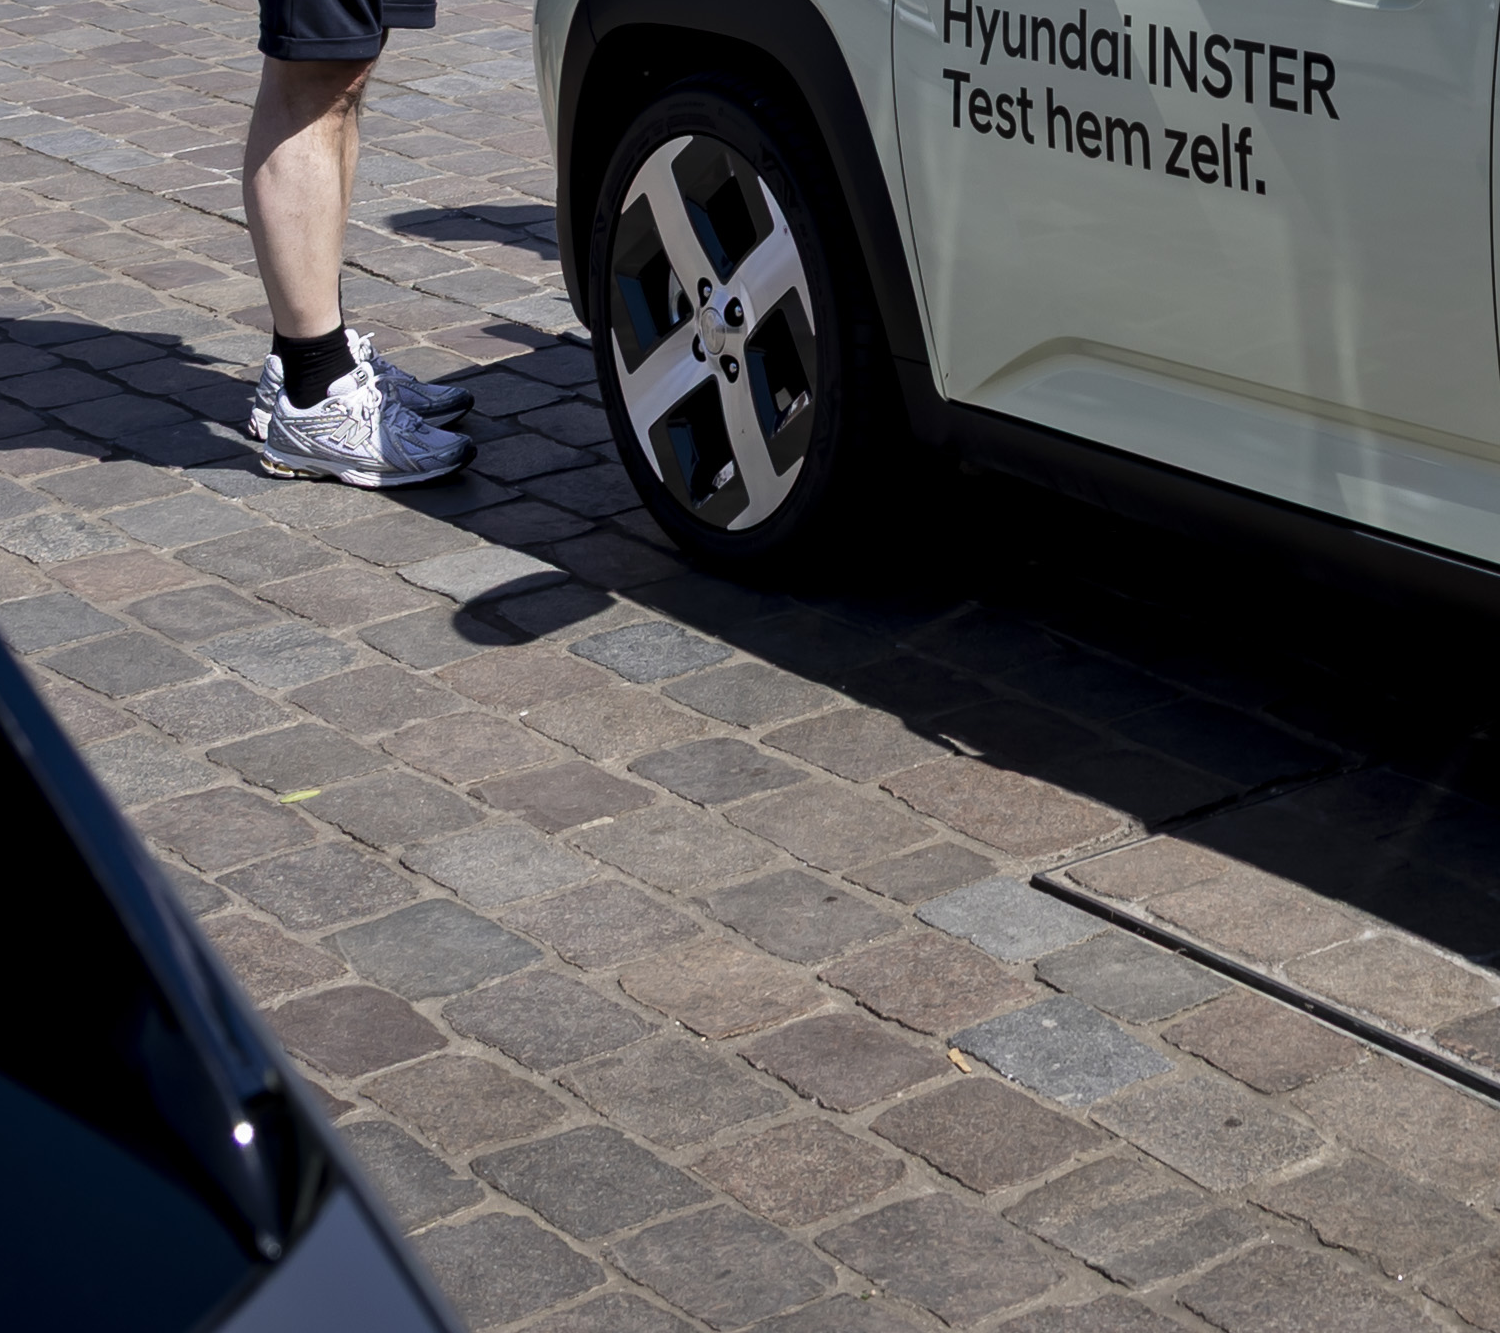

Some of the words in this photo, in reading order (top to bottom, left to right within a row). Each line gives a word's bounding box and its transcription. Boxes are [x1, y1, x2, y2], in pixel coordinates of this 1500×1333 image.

[1148, 22, 1340, 121] INSTER
[942, 68, 1034, 146] Test
[1045, 87, 1152, 171] hem
[1164, 123, 1268, 196] zelf.
